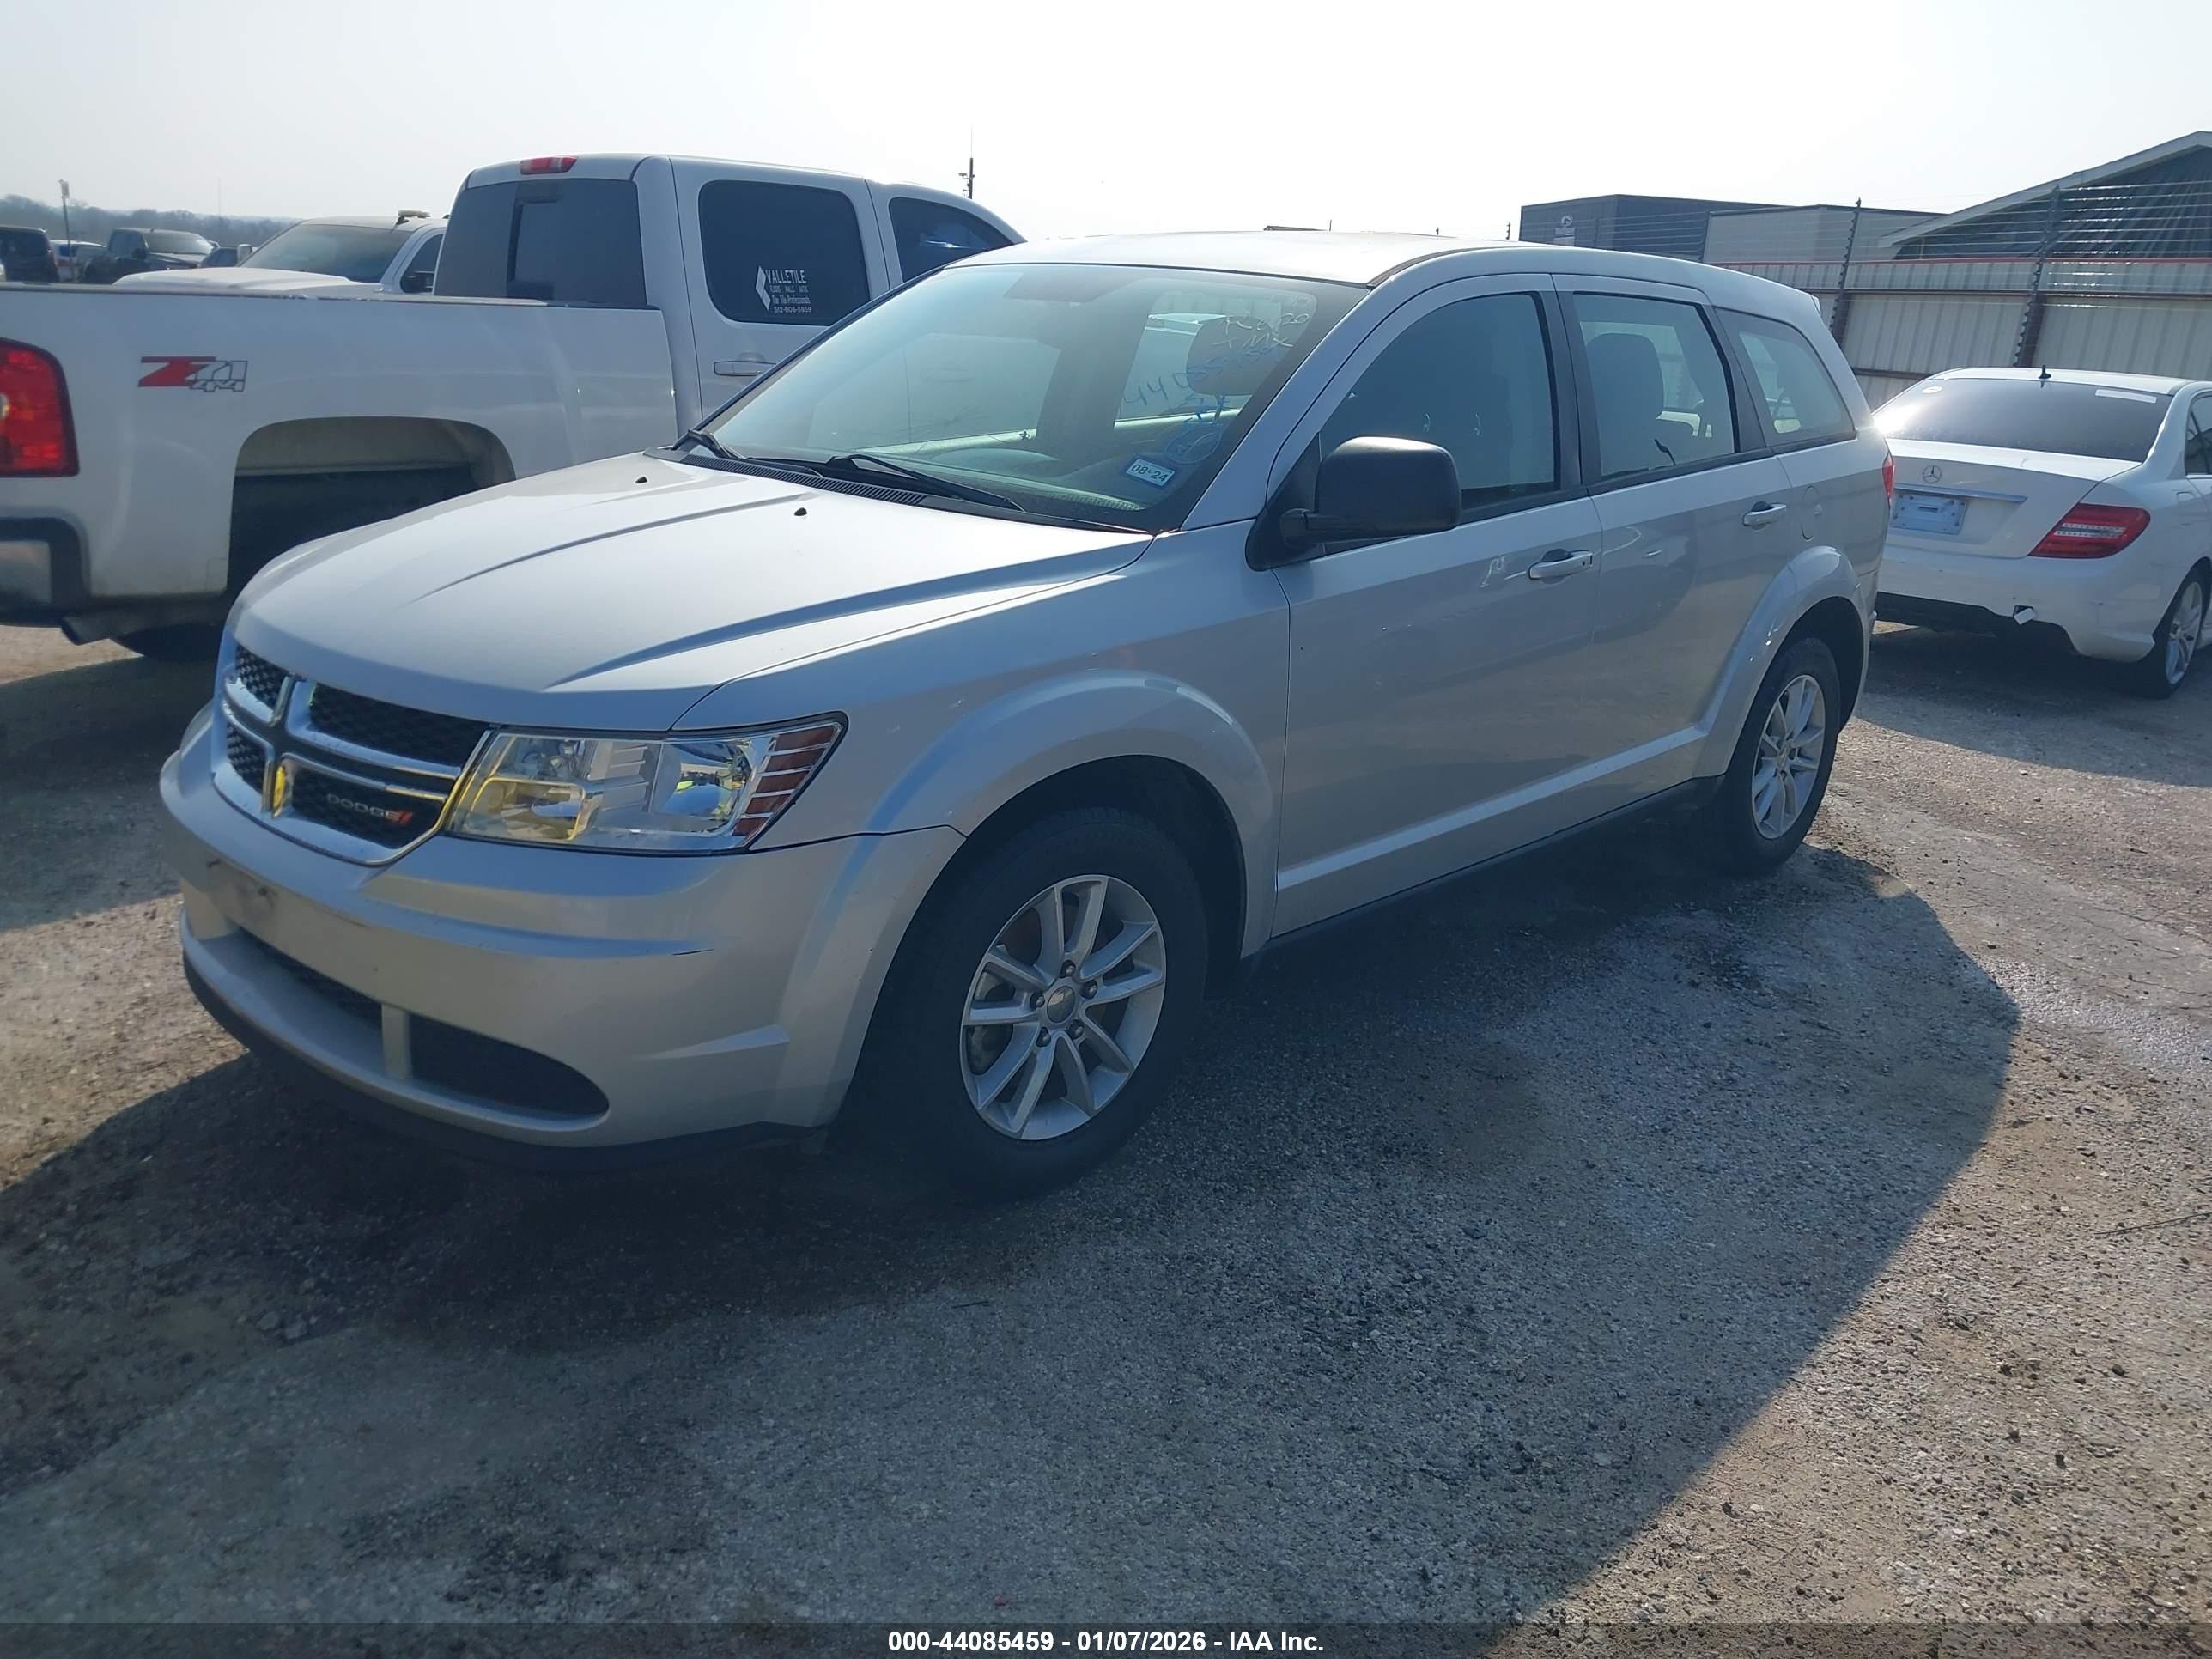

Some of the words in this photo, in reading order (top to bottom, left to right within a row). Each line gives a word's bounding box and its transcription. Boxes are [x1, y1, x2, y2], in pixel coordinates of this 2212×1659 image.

[765, 270, 806, 283] VALLETILE
[137, 356, 248, 386] Z71
[327, 793, 400, 821] DODGE
